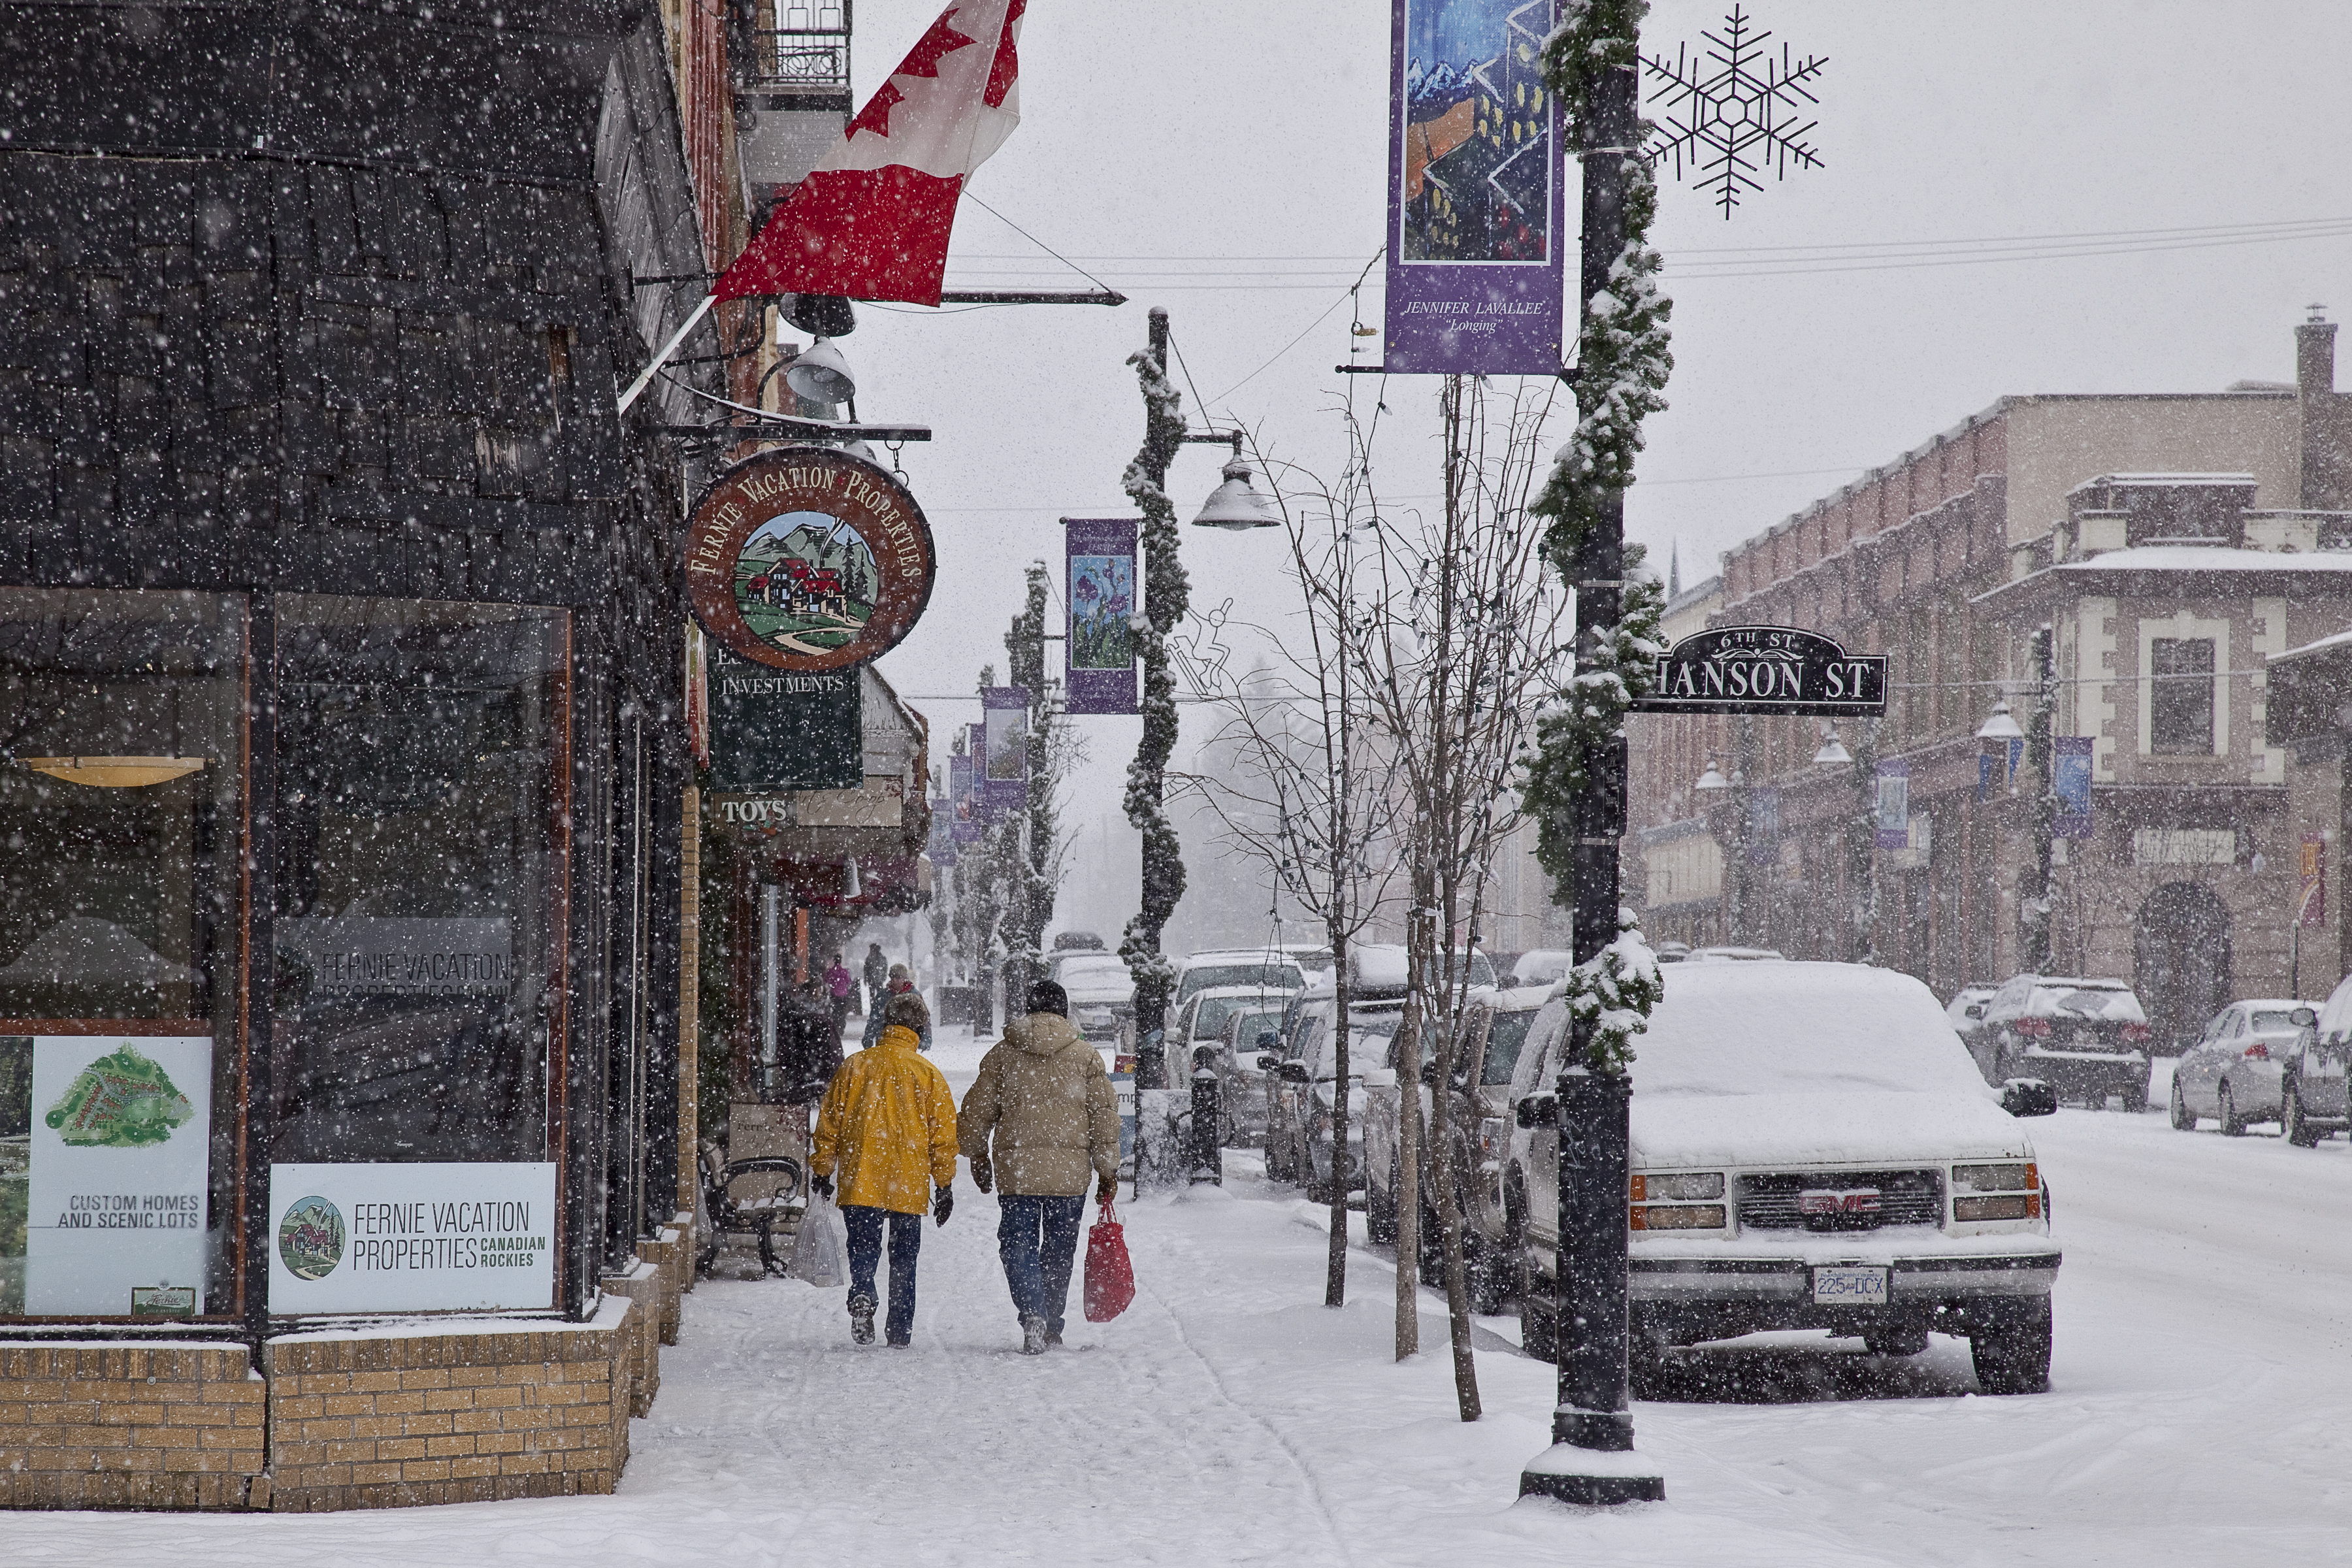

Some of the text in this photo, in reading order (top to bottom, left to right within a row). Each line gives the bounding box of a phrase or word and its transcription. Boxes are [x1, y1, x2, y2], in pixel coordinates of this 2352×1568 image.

[1405, 301, 1543, 314] JENNIFER LAVALLEE
[691, 466, 922, 578] FERNIE VACATION PROPERTIES
[1769, 632, 1795, 648] ST
[722, 676, 844, 694] INVESTMENTS
[1825, 662, 1870, 698] ST
[722, 800, 787, 822] TOYS
[323, 953, 508, 981] FERNIE VACATION
[738, 1120, 775, 1132] Fernie
[70, 1195, 199, 1210] CUSTOM HOMES
[1801, 1194, 1880, 1213] GMC
[58, 1213, 197, 1228] AND SCENIC LOTS
[354, 1201, 529, 1234] FERNIE VACATION
[480, 1237, 546, 1251] CANADIAN
[353, 1237, 477, 1271] PROPERTIES
[480, 1253, 533, 1267] ROCKIES
